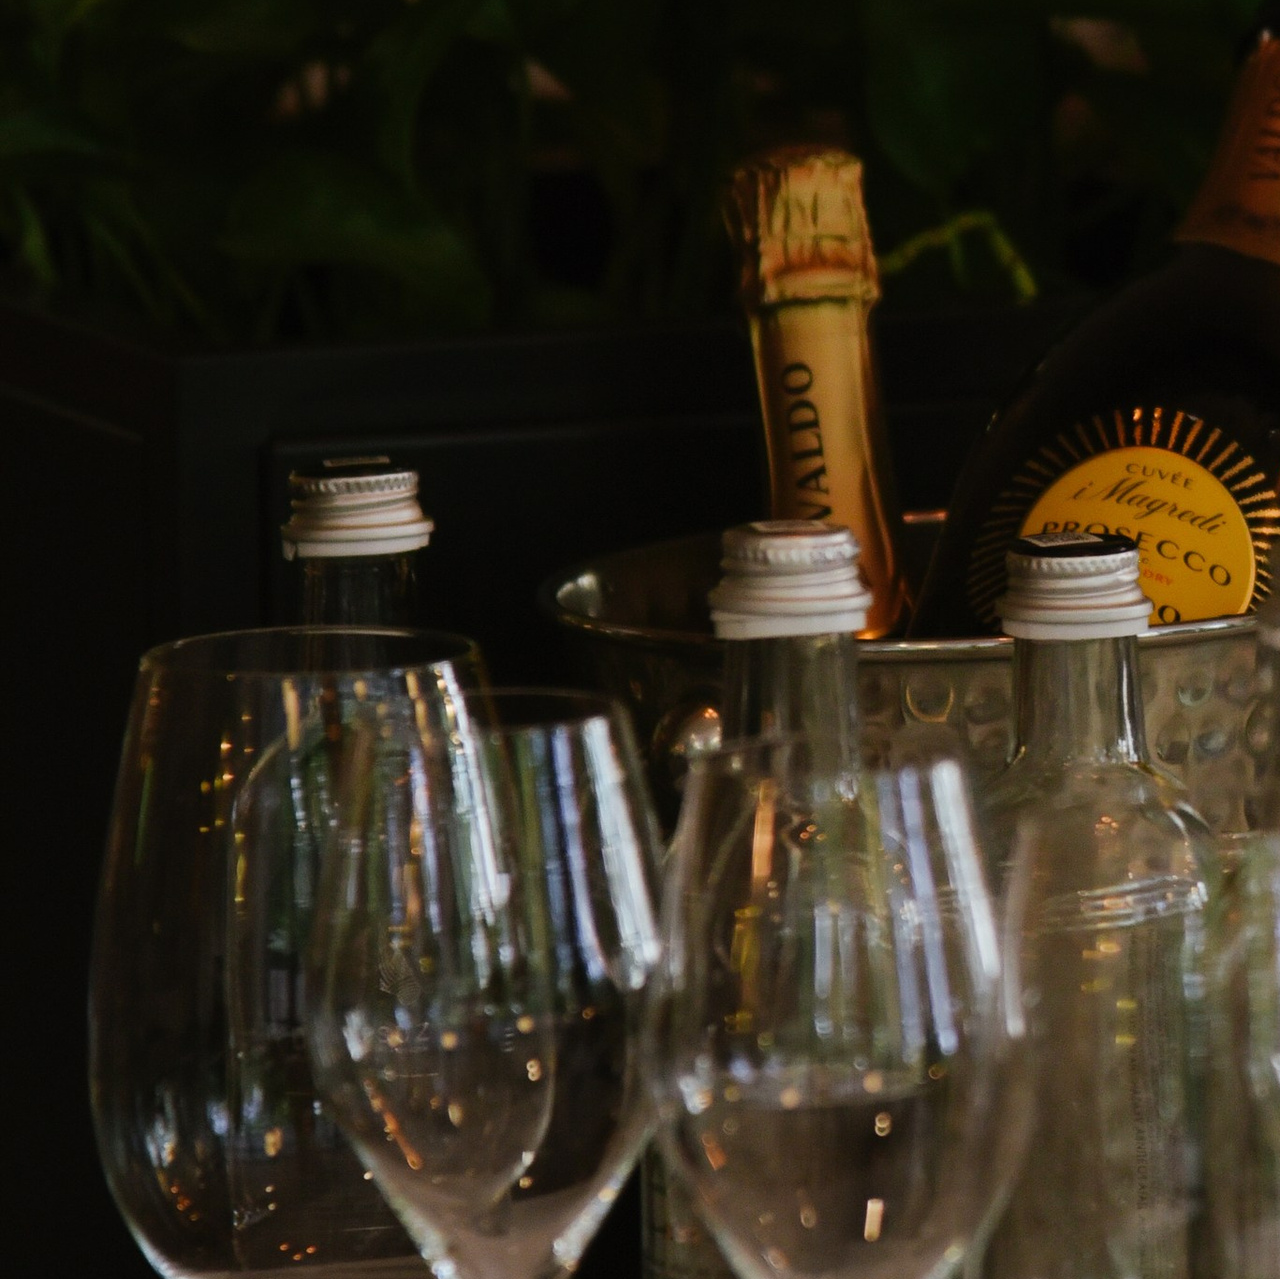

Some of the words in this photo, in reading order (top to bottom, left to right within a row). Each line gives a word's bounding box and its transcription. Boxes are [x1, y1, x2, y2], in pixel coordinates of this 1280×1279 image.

[781, 361, 832, 520] VALDO
[1090, 476, 1229, 537] Magredi
[1125, 461, 1195, 491] CUVÉE
